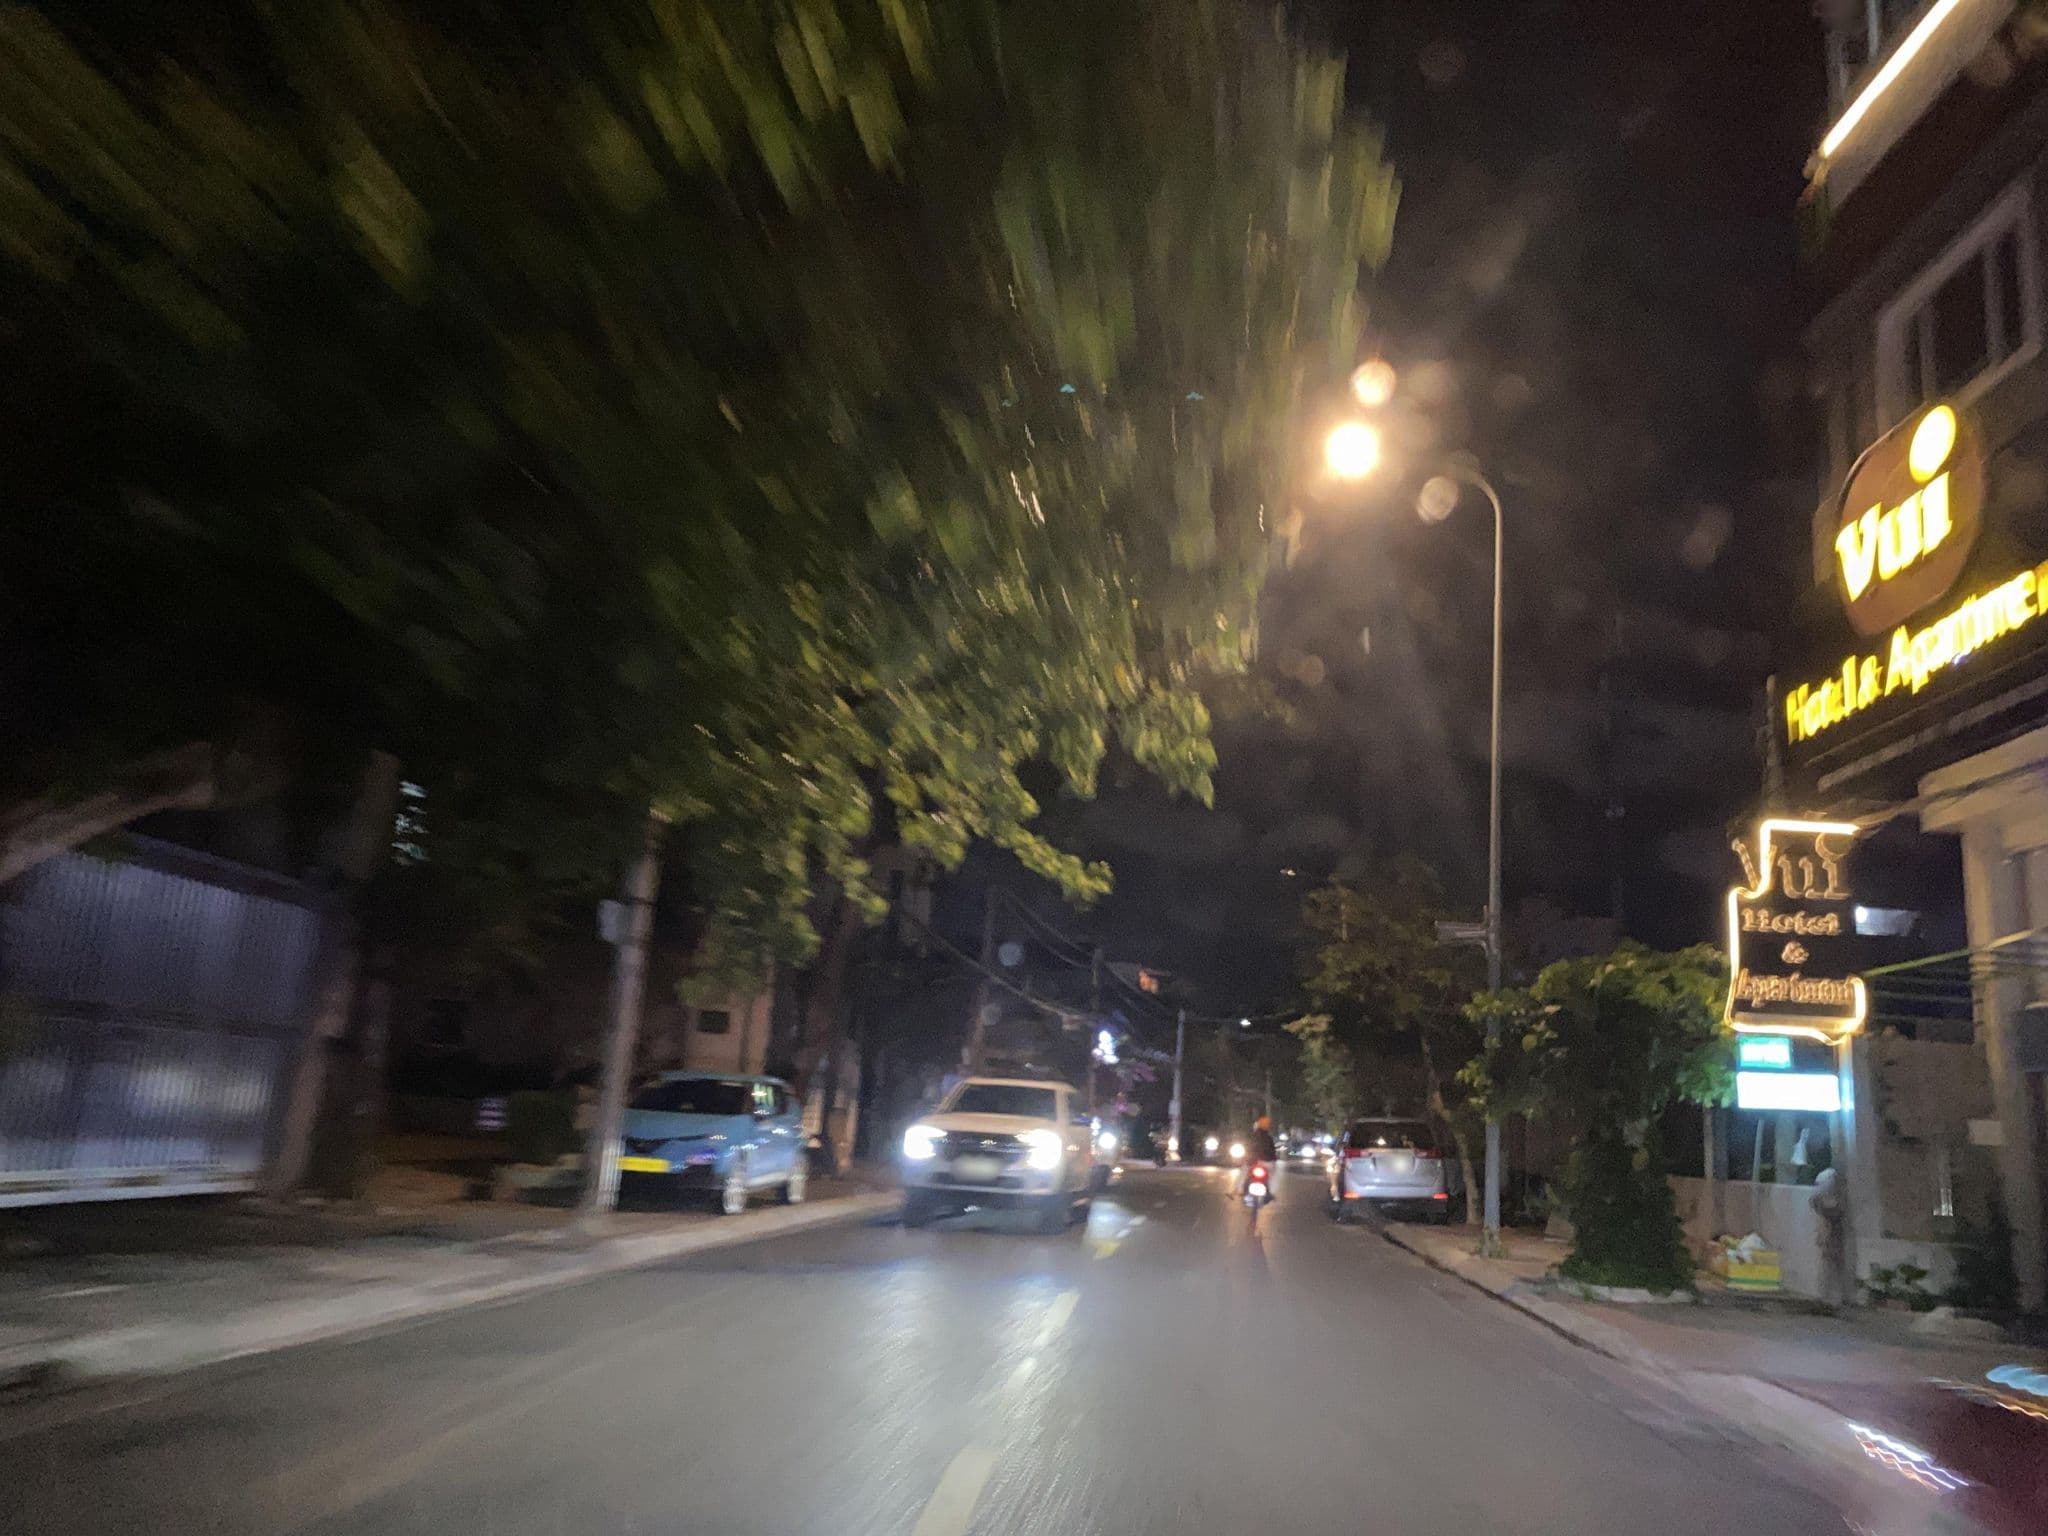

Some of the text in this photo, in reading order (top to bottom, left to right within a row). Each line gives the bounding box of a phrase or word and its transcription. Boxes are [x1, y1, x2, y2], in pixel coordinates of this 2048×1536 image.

[1786, 654, 1857, 744] Hotel
[1858, 655, 1883, 709] &
[1740, 908, 1842, 936] Hotel
[1781, 941, 1809, 964] &
